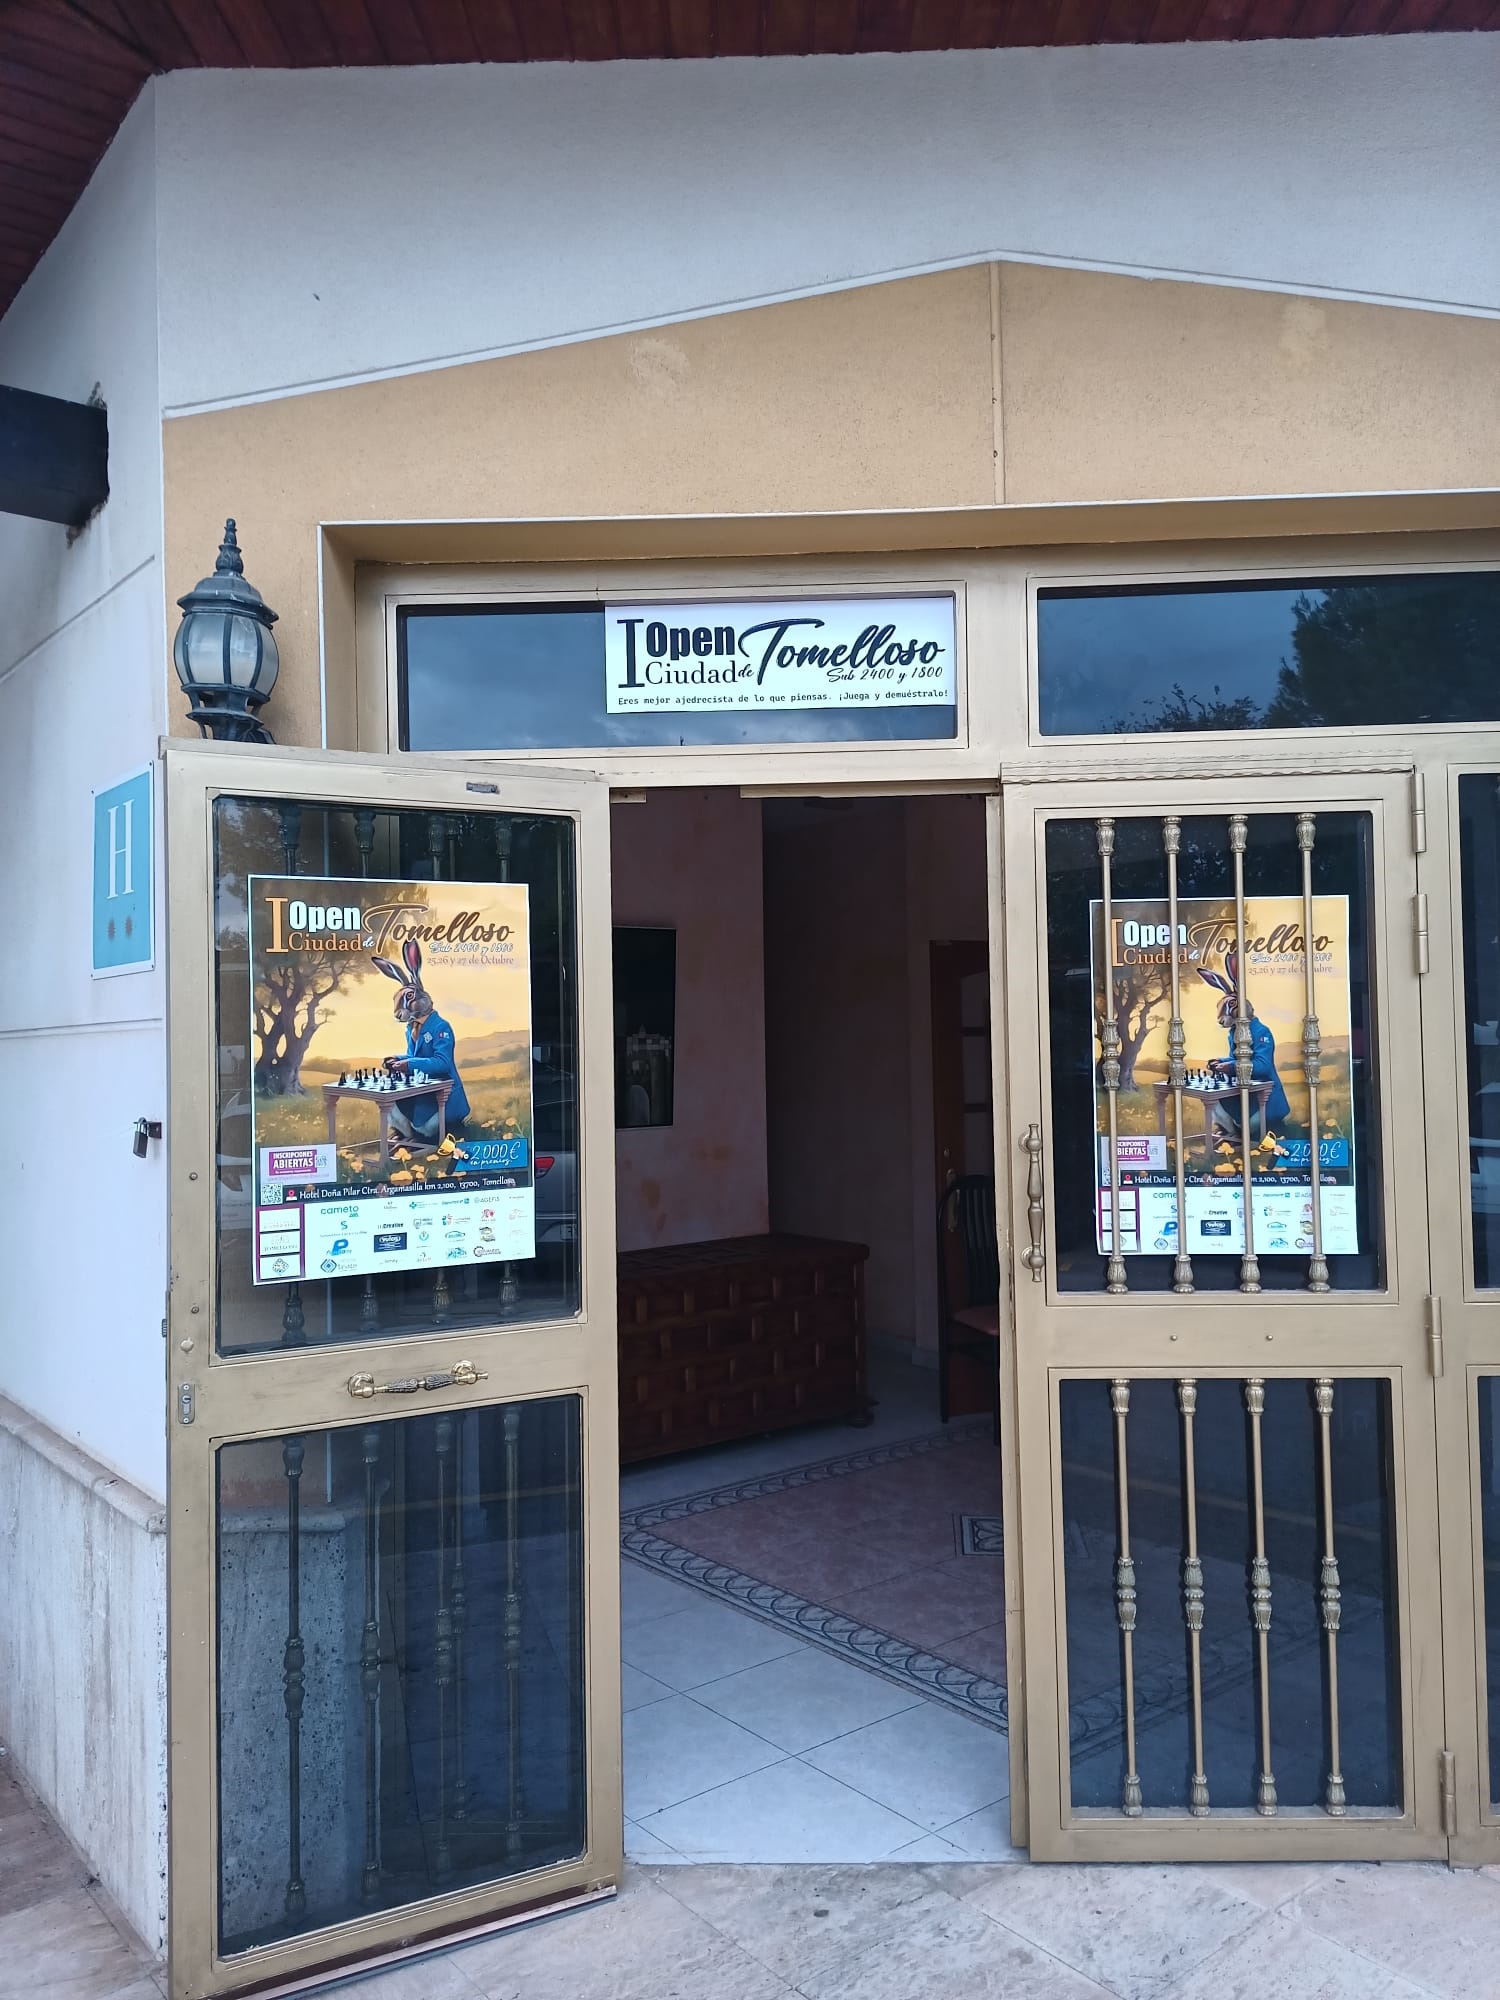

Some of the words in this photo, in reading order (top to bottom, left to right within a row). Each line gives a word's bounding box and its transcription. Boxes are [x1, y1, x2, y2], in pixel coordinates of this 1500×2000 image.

[617, 618, 645, 688] I
[646, 621, 735, 660] Open
[738, 618, 946, 686] Tomelloso
[645, 660, 738, 685] Ciudad
[738, 664, 754, 678] de
[826, 667, 856, 682] Sub
[860, 668, 894, 680] 2400
[897, 672, 907, 684] y
[911, 666, 943, 678] 1800
[618, 697, 639, 705] Eres
[644, 696, 670, 705] mejor
[675, 695, 733, 705] ajedrecista
[754, 694, 764, 702] lo
[770, 695, 785, 703] que
[791, 692, 832, 702] piensas.
[839, 692, 870, 701] ¡Juega
[885, 689, 948, 699] demuéstralo!
[107, 799, 134, 899] H
[265, 897, 289, 953] I
[289, 900, 361, 932] Open
[361, 903, 515, 954] Tomelloso
[288, 932, 362, 951] Ciudad
[362, 936, 375, 948] de
[1123, 920, 1187, 948] Open
[429, 942, 451, 953] Sub
[481, 946, 488, 956] y
[1188, 950, 1200, 960] de
[468, 954, 477, 964] de
[481, 954, 514, 964] Octubre
[1288, 963, 1297, 973] de
[273, 1151, 313, 1159] INSCRIPCIONES
[1117, 1147, 1147, 1156] BIERTAS
[273, 1158, 313, 1169] ABIERTAS
[300, 1189, 320, 1199] Hotel
[321, 1189, 341, 1198] Doña
[343, 1186, 360, 1196] Pilar
[380, 1182, 423, 1196] Argamasilla
[425, 1182, 436, 1190] km
